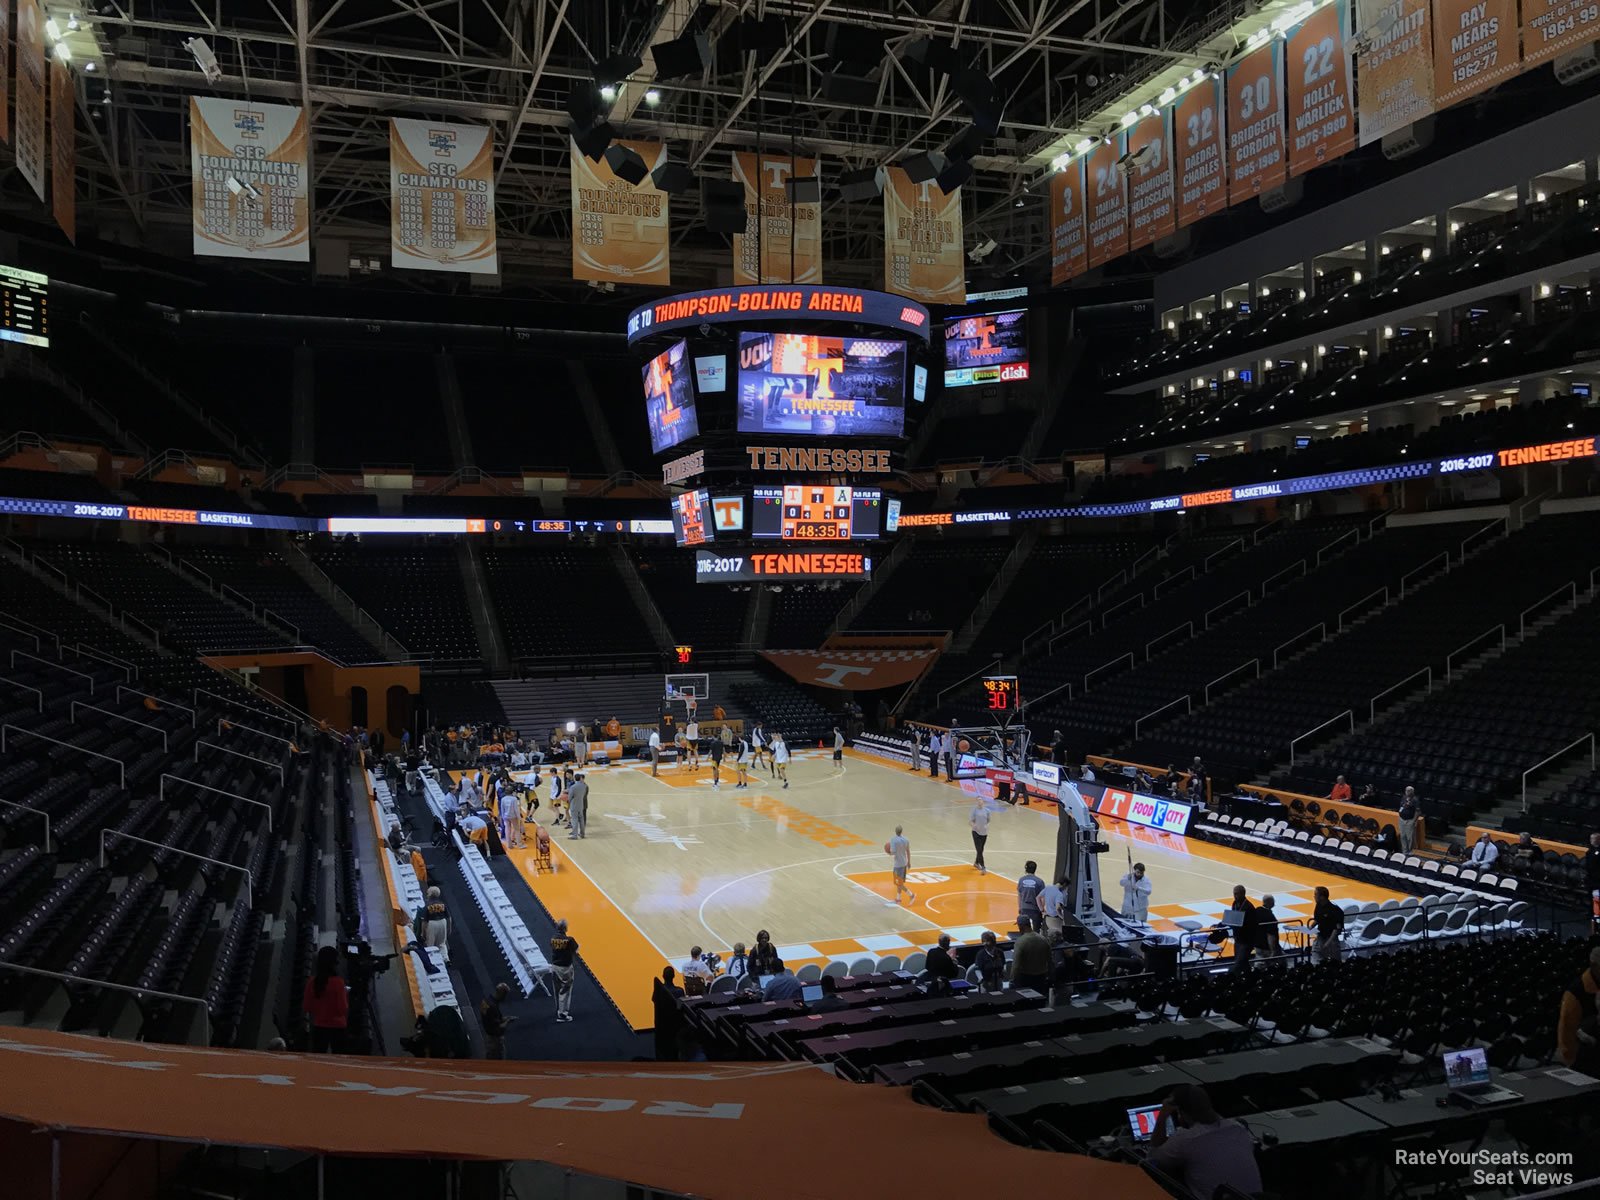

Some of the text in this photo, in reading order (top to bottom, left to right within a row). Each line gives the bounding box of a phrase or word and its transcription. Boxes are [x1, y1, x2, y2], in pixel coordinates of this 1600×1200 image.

[1459, 1, 1487, 30] RAY
[1541, 5, 1599, 42] 1964-99
[1450, 17, 1499, 54] MEARS
[1303, 36, 1334, 86] 22
[1453, 38, 1498, 66] HEAD COACH
[1452, 51, 1498, 84] 1962-77
[1240, 75, 1270, 121] 30
[1303, 80, 1336, 111] HOLLY
[1295, 94, 1344, 134] WARLICK
[1186, 106, 1212, 149] 32
[1294, 115, 1347, 150] 1976-1980
[234, 145, 266, 160] SEC
[1236, 131, 1276, 162] GORDON
[200, 154, 300, 175] TOURNAMENT
[1184, 143, 1218, 171] DAEDRA
[202, 168, 299, 188] CHAMPIONS
[428, 162, 458, 176] SEC
[1096, 160, 1118, 197] 24
[1183, 158, 1220, 188] CHARLES
[398, 173, 488, 192] CHAMPIONS
[607, 179, 633, 192] SEC
[578, 188, 662, 207] TOURNAMENT
[1064, 187, 1072, 214] 3
[580, 200, 662, 218] CHAMPIONS
[898, 228, 954, 244] DIVISION
[640, 308, 652, 326] TO
[655, 291, 802, 324] THOMPSON-BOLING
[808, 292, 863, 313] ARENA
[1002, 366, 1028, 380] dish
[783, 408, 863, 417] BASKETBALL
[790, 398, 855, 412] TENNESSEE
[662, 449, 704, 486] TENNESSEE
[746, 446, 892, 473] TENNESSEE
[898, 513, 953, 526] ENNESSEE
[955, 511, 1010, 522] BASKETBALL
[1149, 498, 1180, 510] 2016-2017
[1181, 488, 1232, 508] TENNESSEE
[1234, 484, 1282, 500] BASKETBALL
[1439, 454, 1493, 473] 2016-2017
[1498, 438, 1598, 468] TENNESSEE
[838, 490, 847, 502] A
[74, 503, 252, 525] 2016-2017 TENNESSEE BASKETBALL
[790, 508, 796, 517] 0
[839, 508, 845, 517] 0
[494, 521, 500, 530] 0
[538, 522, 565, 530] 48:35
[616, 522, 623, 530] 0
[797, 525, 836, 536] 48:35
[750, 554, 864, 574] TENNESSEE
[678, 652, 690, 664] 30
[984, 680, 1010, 691] 48:34
[988, 691, 1008, 710] 30
[1035, 768, 1056, 779] verizon
[1132, 802, 1154, 818] FOOD
[1166, 810, 1184, 824] CITY
